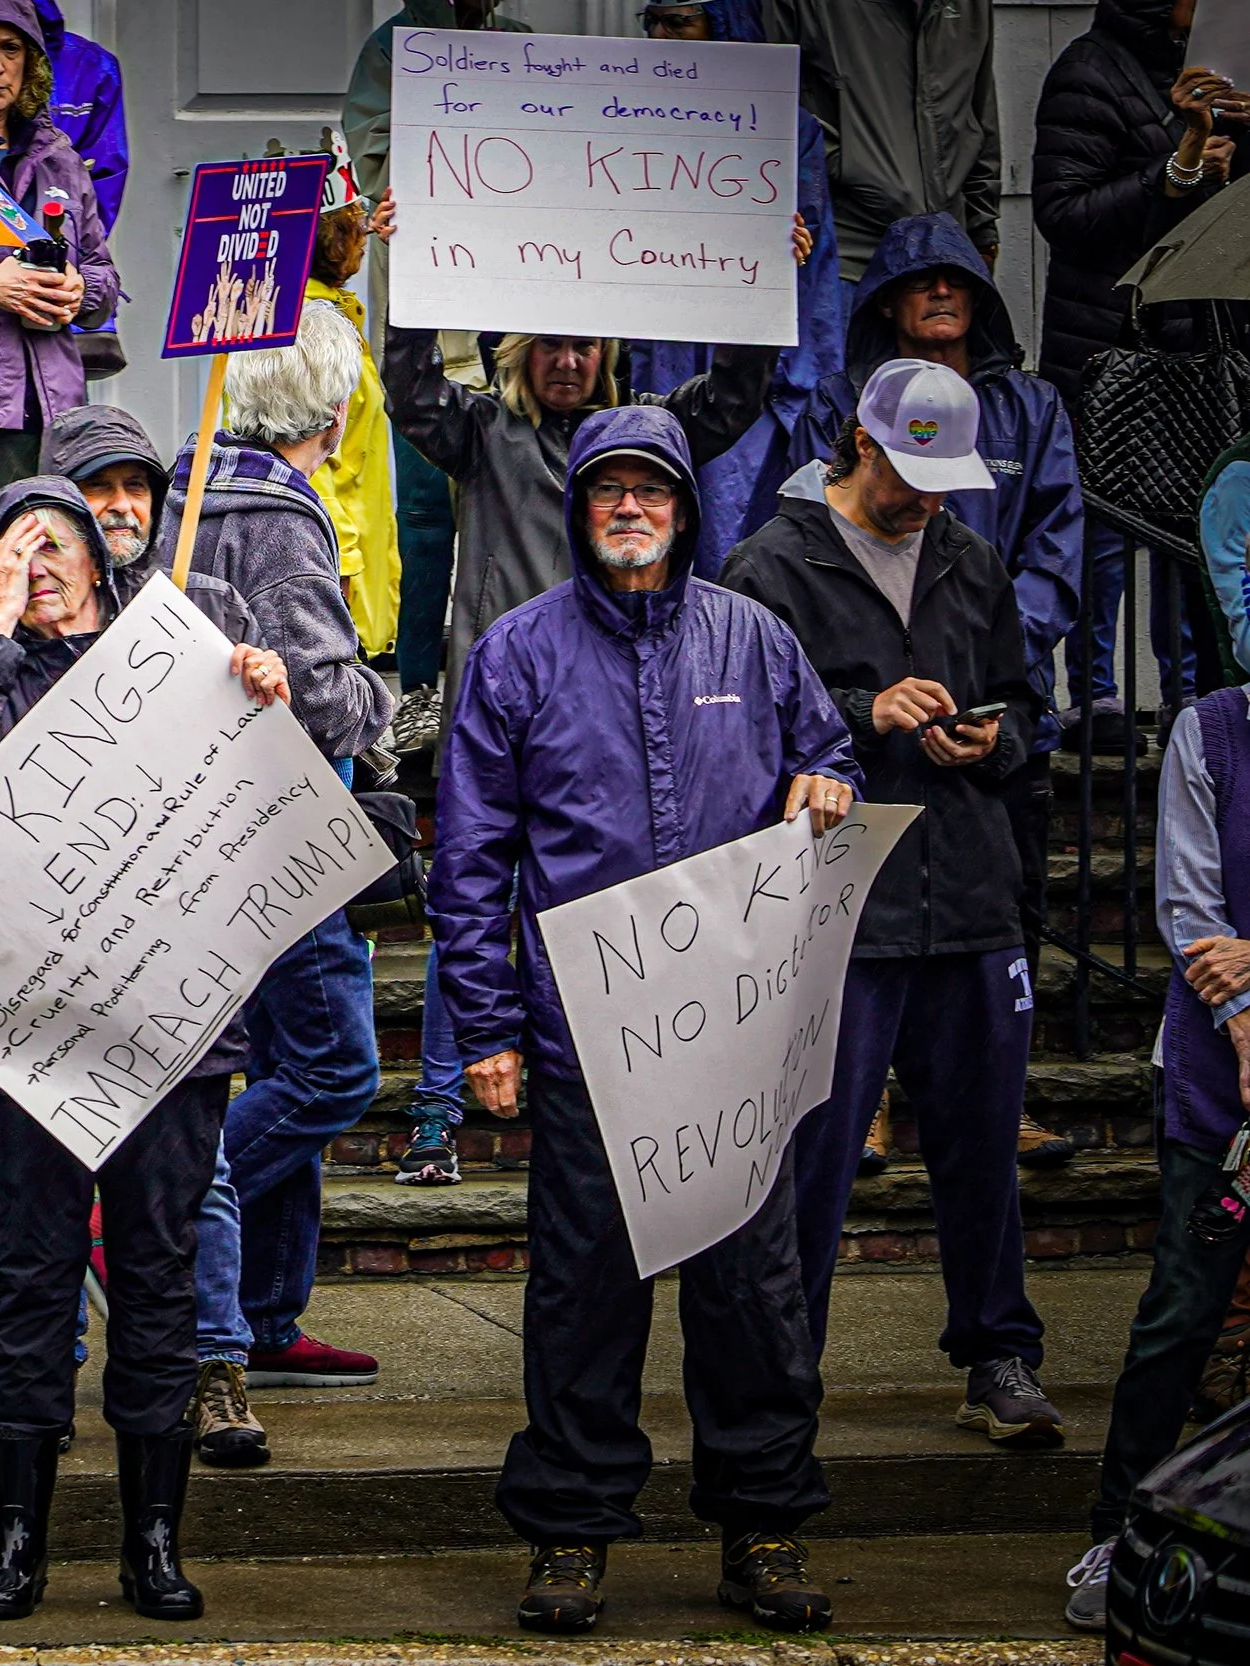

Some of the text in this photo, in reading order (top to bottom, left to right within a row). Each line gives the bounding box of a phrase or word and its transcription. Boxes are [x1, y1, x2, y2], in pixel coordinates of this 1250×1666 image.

[401, 31, 510, 73] Soldiers
[600, 57, 639, 75] and
[653, 60, 698, 79] died
[433, 82, 757, 131] for our democracy!
[232, 171, 287, 200] UNITED
[427, 130, 781, 204] NO KINGS
[217, 230, 279, 263] DIVIDED
[238, 203, 271, 230] NOT
[430, 228, 760, 285] in my Country
[702, 694, 741, 705] Columbia
[163, 773, 207, 812] Rule
[204, 744, 219, 765] of
[8, 779, 254, 1047] Cruelty and Retribution
[33, 1024, 95, 1077] Personal
[179, 874, 219, 916] from
[593, 901, 699, 994] NO
[51, 950, 241, 1158] IMPEACH
[621, 1000, 706, 1072] NO
